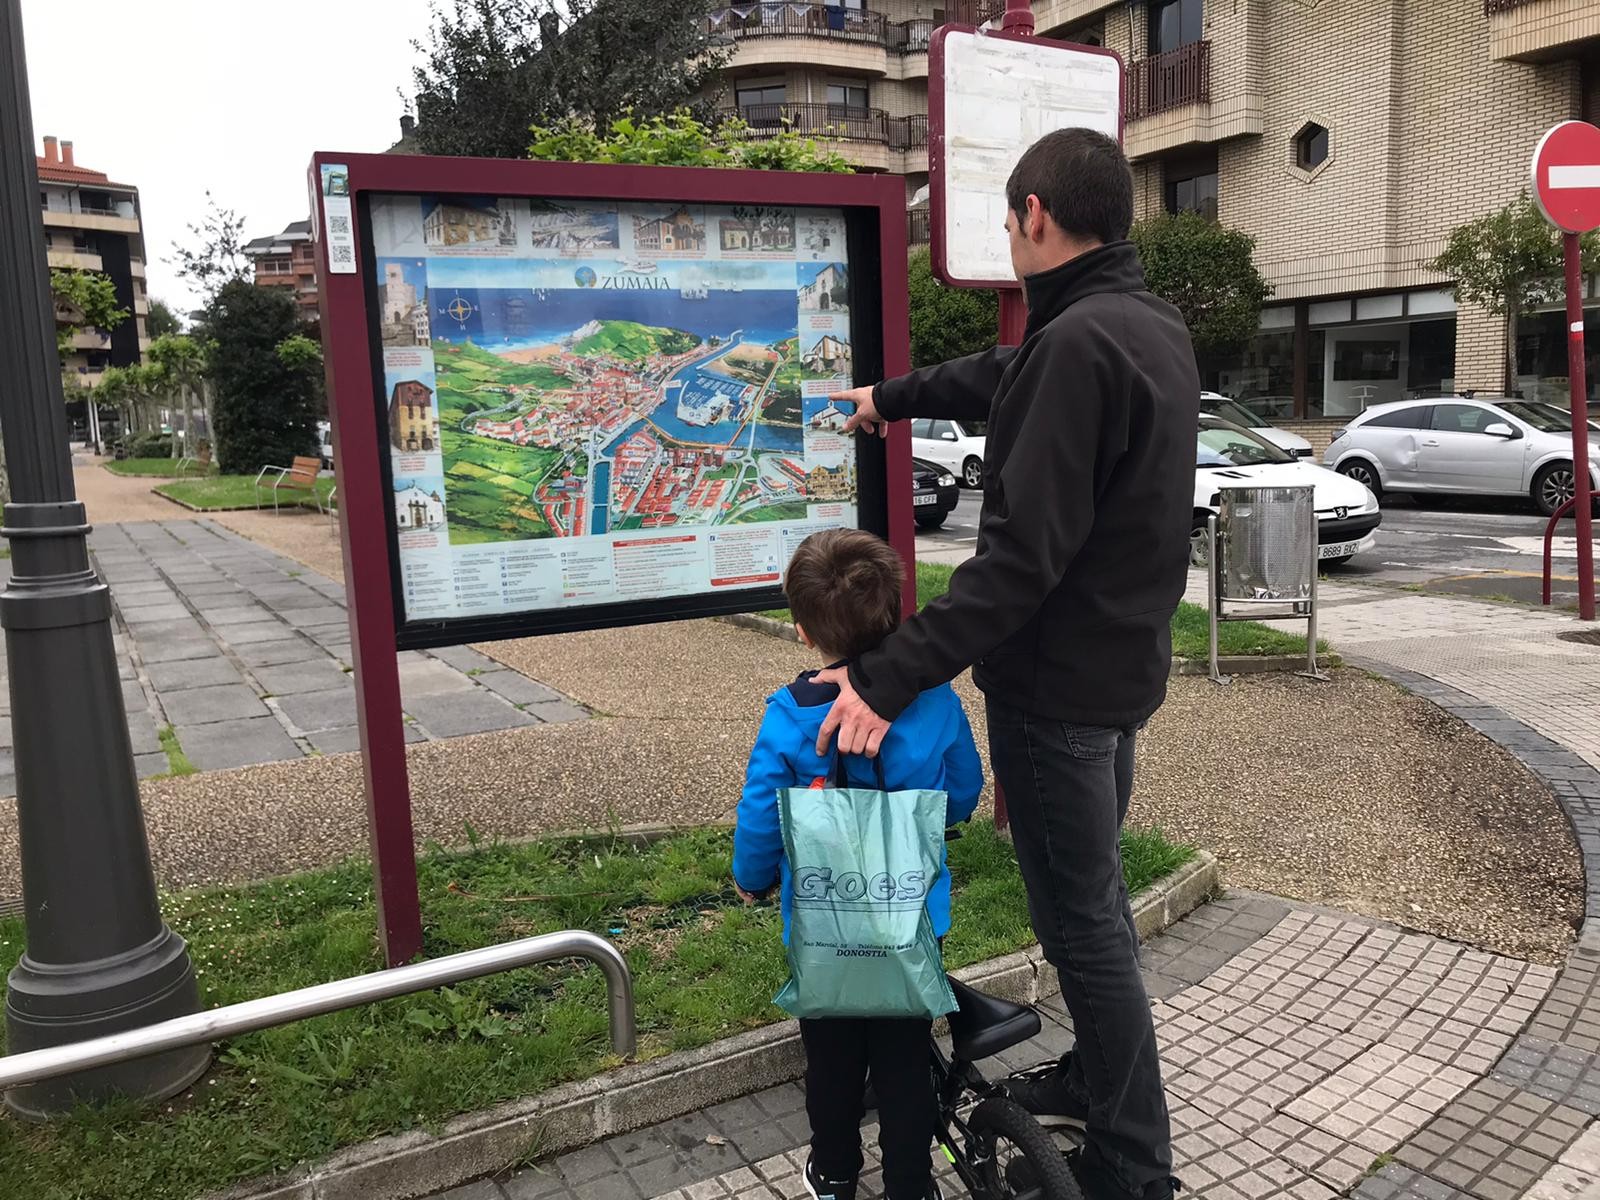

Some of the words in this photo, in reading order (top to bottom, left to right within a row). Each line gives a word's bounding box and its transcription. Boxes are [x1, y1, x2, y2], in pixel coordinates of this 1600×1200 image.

[601, 276, 671, 290] ZUMAIA
[1322, 545, 1342, 557] 8689
[836, 949, 888, 958] DONOSTIA
